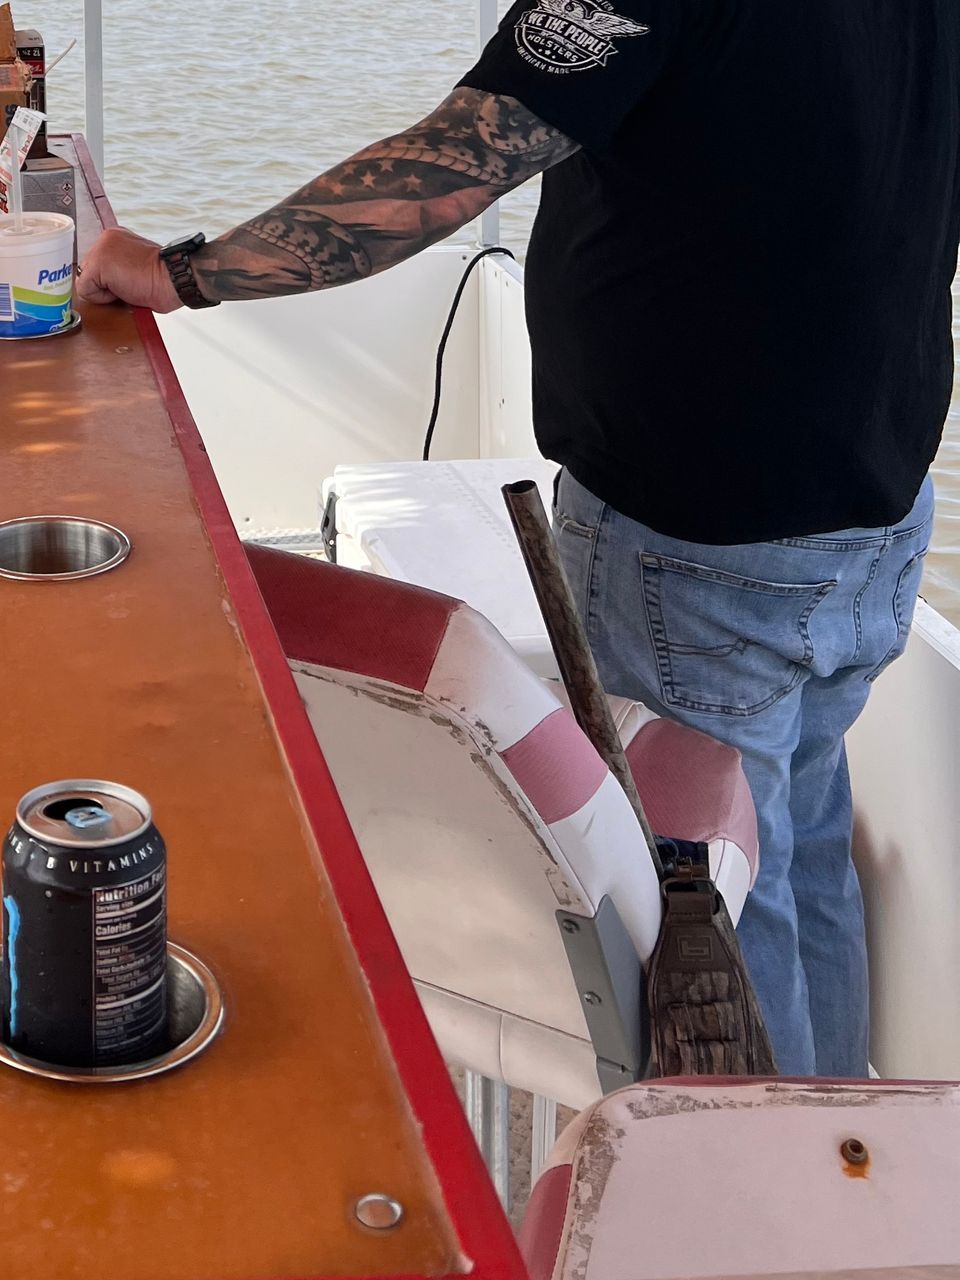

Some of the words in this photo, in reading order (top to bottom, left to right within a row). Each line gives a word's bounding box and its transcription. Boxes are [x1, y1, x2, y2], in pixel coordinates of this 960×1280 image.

[528, 11, 546, 26] WE
[544, 17, 569, 36] THE
[564, 24, 607, 55] PEOPLE
[526, 34, 579, 62] HOLSTERS
[46, 856, 56, 869] B
[69, 842, 154, 874] VITAMINS
[96, 881, 149, 903] Nutrition
[96, 923, 131, 936] Calories
